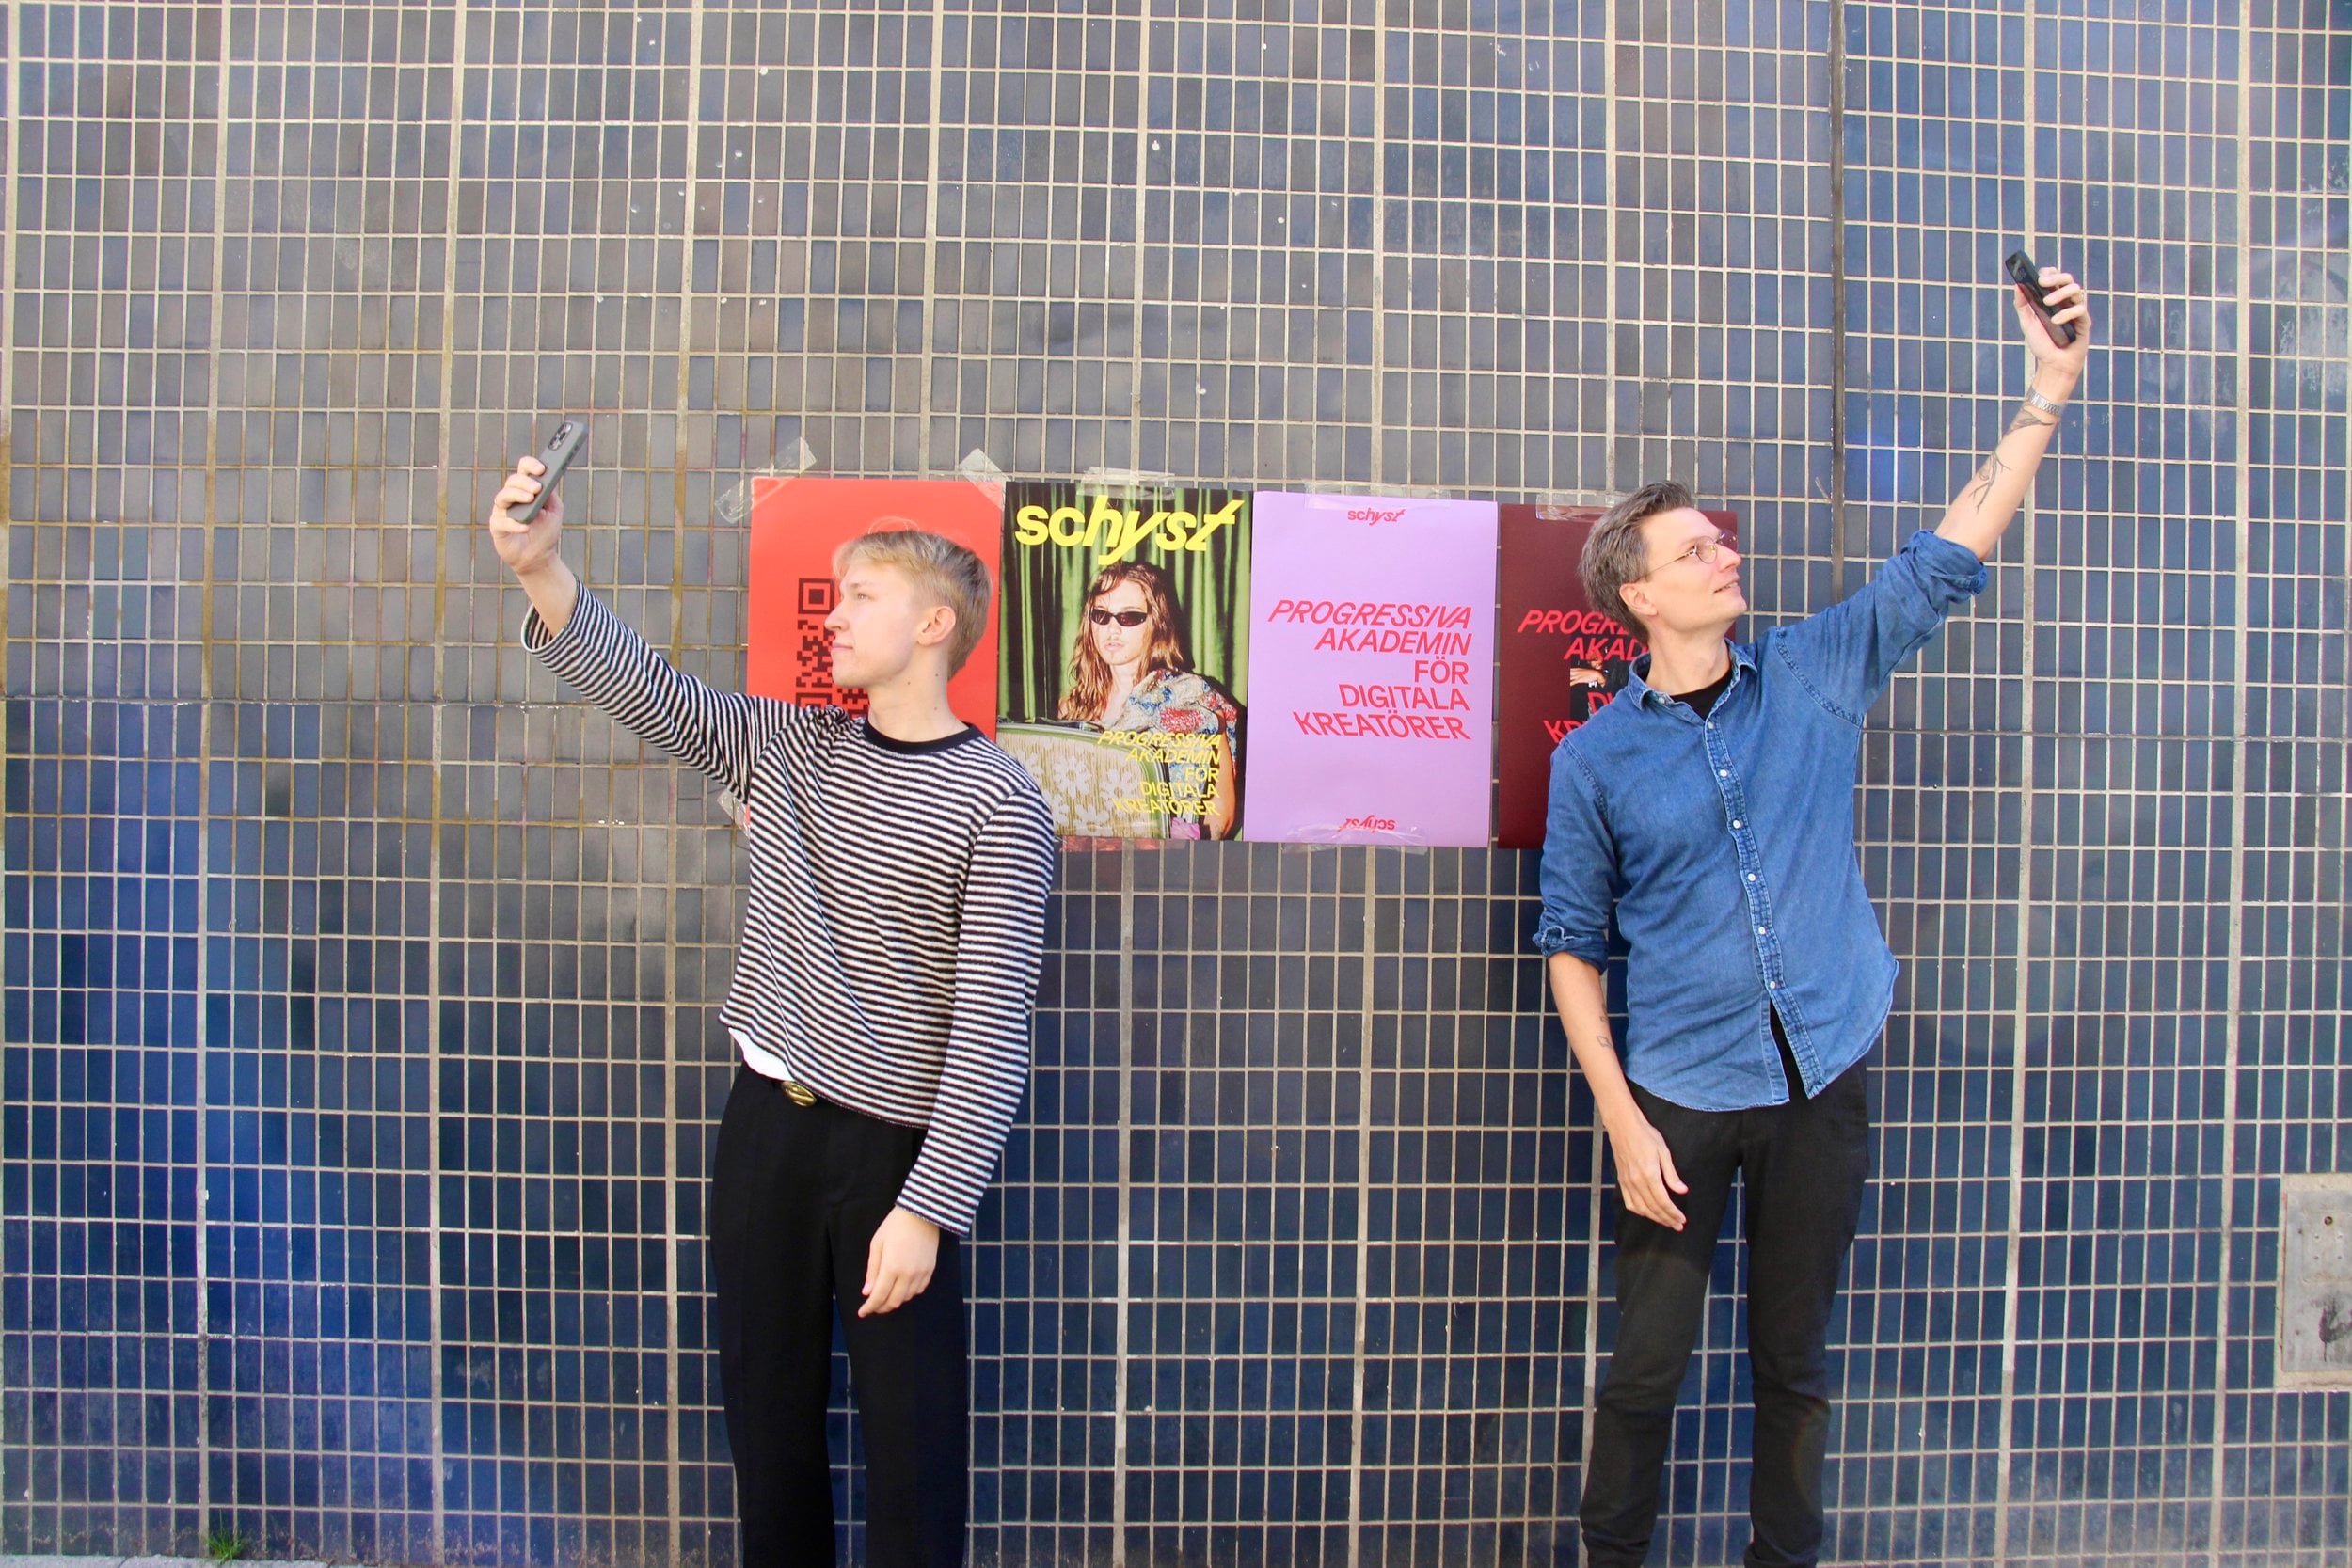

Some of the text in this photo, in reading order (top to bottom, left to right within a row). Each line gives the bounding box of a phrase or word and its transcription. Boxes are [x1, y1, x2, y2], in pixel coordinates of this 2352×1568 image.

[1015, 495, 1245, 565] schyst
[1347, 507, 1406, 526] schyst
[1268, 600, 1472, 628] PROGRESSIVA
[1314, 628, 1472, 655] AKADEMIN
[1414, 656, 1470, 684] FÖR
[1339, 684, 1470, 711] DIGITALA
[1293, 709, 1471, 740] KREATÖRER
[1098, 731, 1222, 749] PROGRESSIVA
[1126, 748, 1222, 765] AKADEMIN
[1140, 781, 1220, 798] DIGITALA
